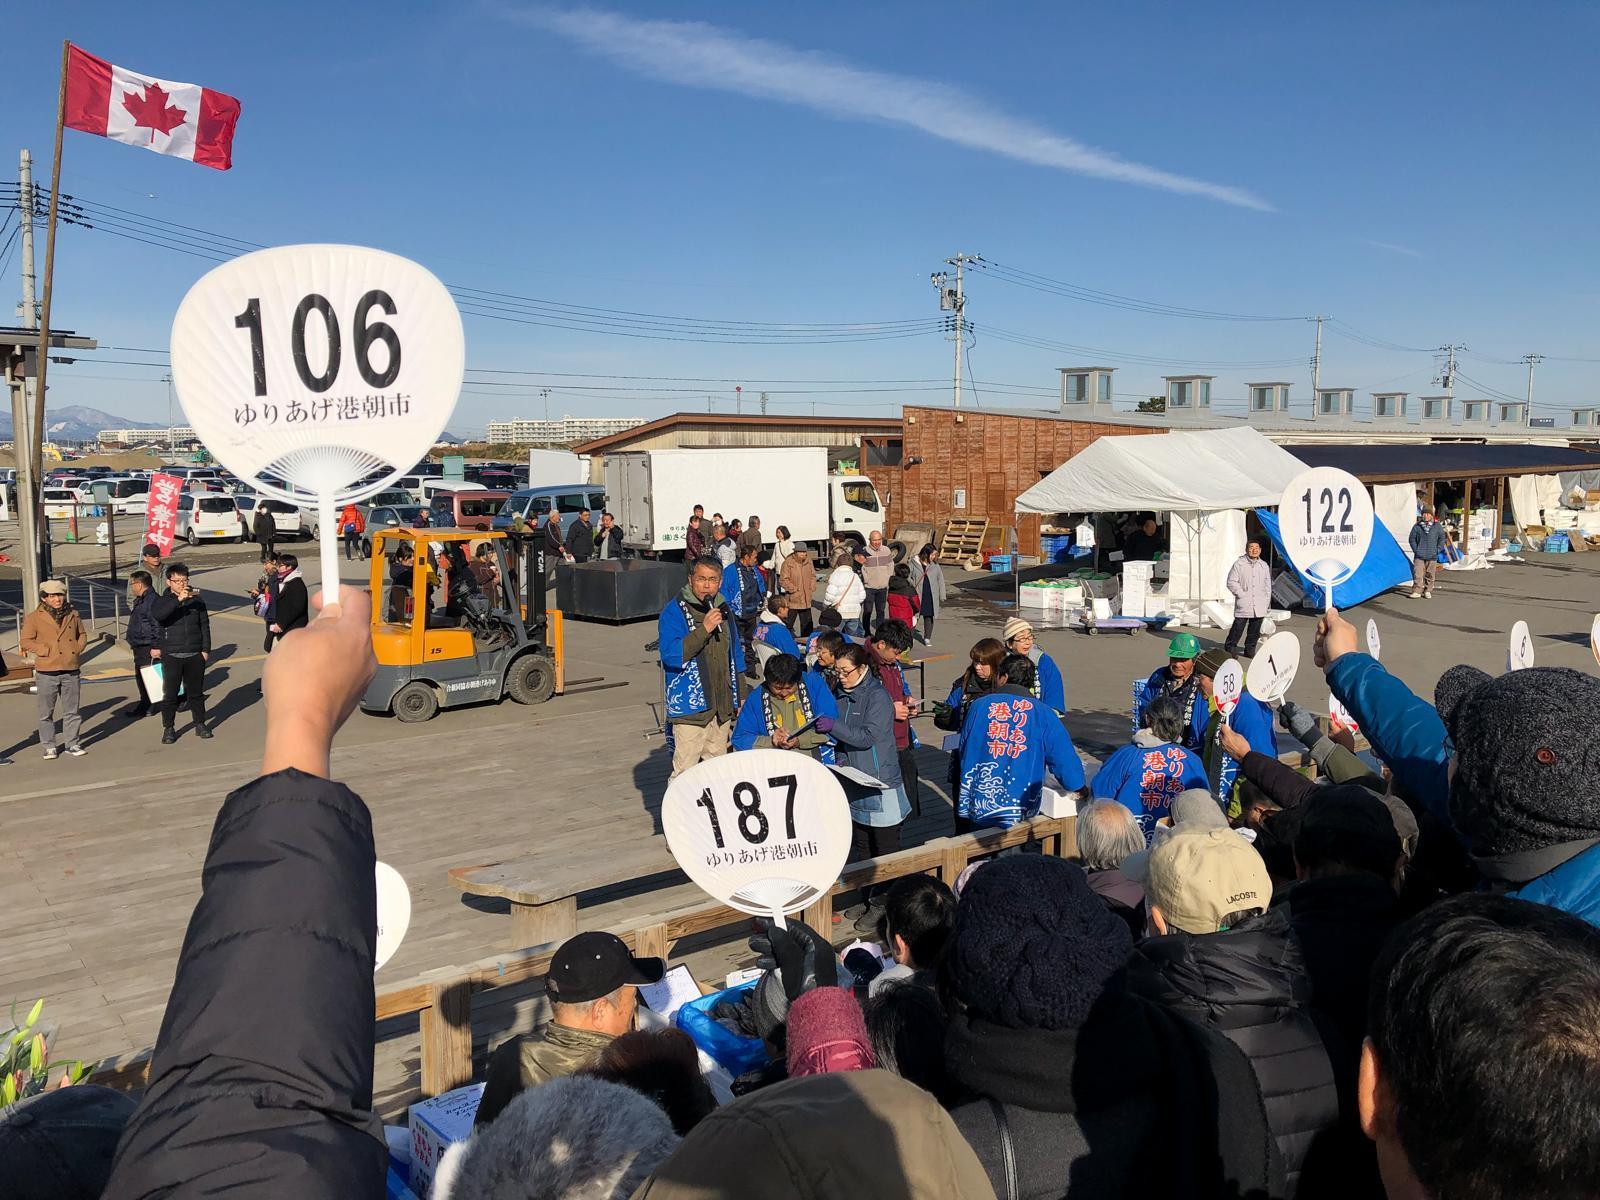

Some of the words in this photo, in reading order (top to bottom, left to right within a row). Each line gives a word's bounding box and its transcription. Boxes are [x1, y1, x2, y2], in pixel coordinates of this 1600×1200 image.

[235, 289, 402, 396] 106
[234, 393, 411, 428] ゆりあげ港朝市
[148, 479, 178, 548] 営業中
[1302, 487, 1354, 534] 122
[1299, 535, 1357, 547] ゆりあげ港朝市
[537, 550, 545, 573] TCM
[1223, 673, 1234, 695] 58
[1268, 654, 1277, 676] 1
[799, 683, 814, 722] ゆりあげ港
[987, 702, 1012, 759] 港朝市
[1007, 699, 1033, 759] ゆりあげ
[1140, 752, 1168, 810] 港朝市
[696, 774, 798, 849] 187
[706, 841, 818, 868] ゆりあげ港朝市
[1226, 891, 1258, 904] LACOSTE
